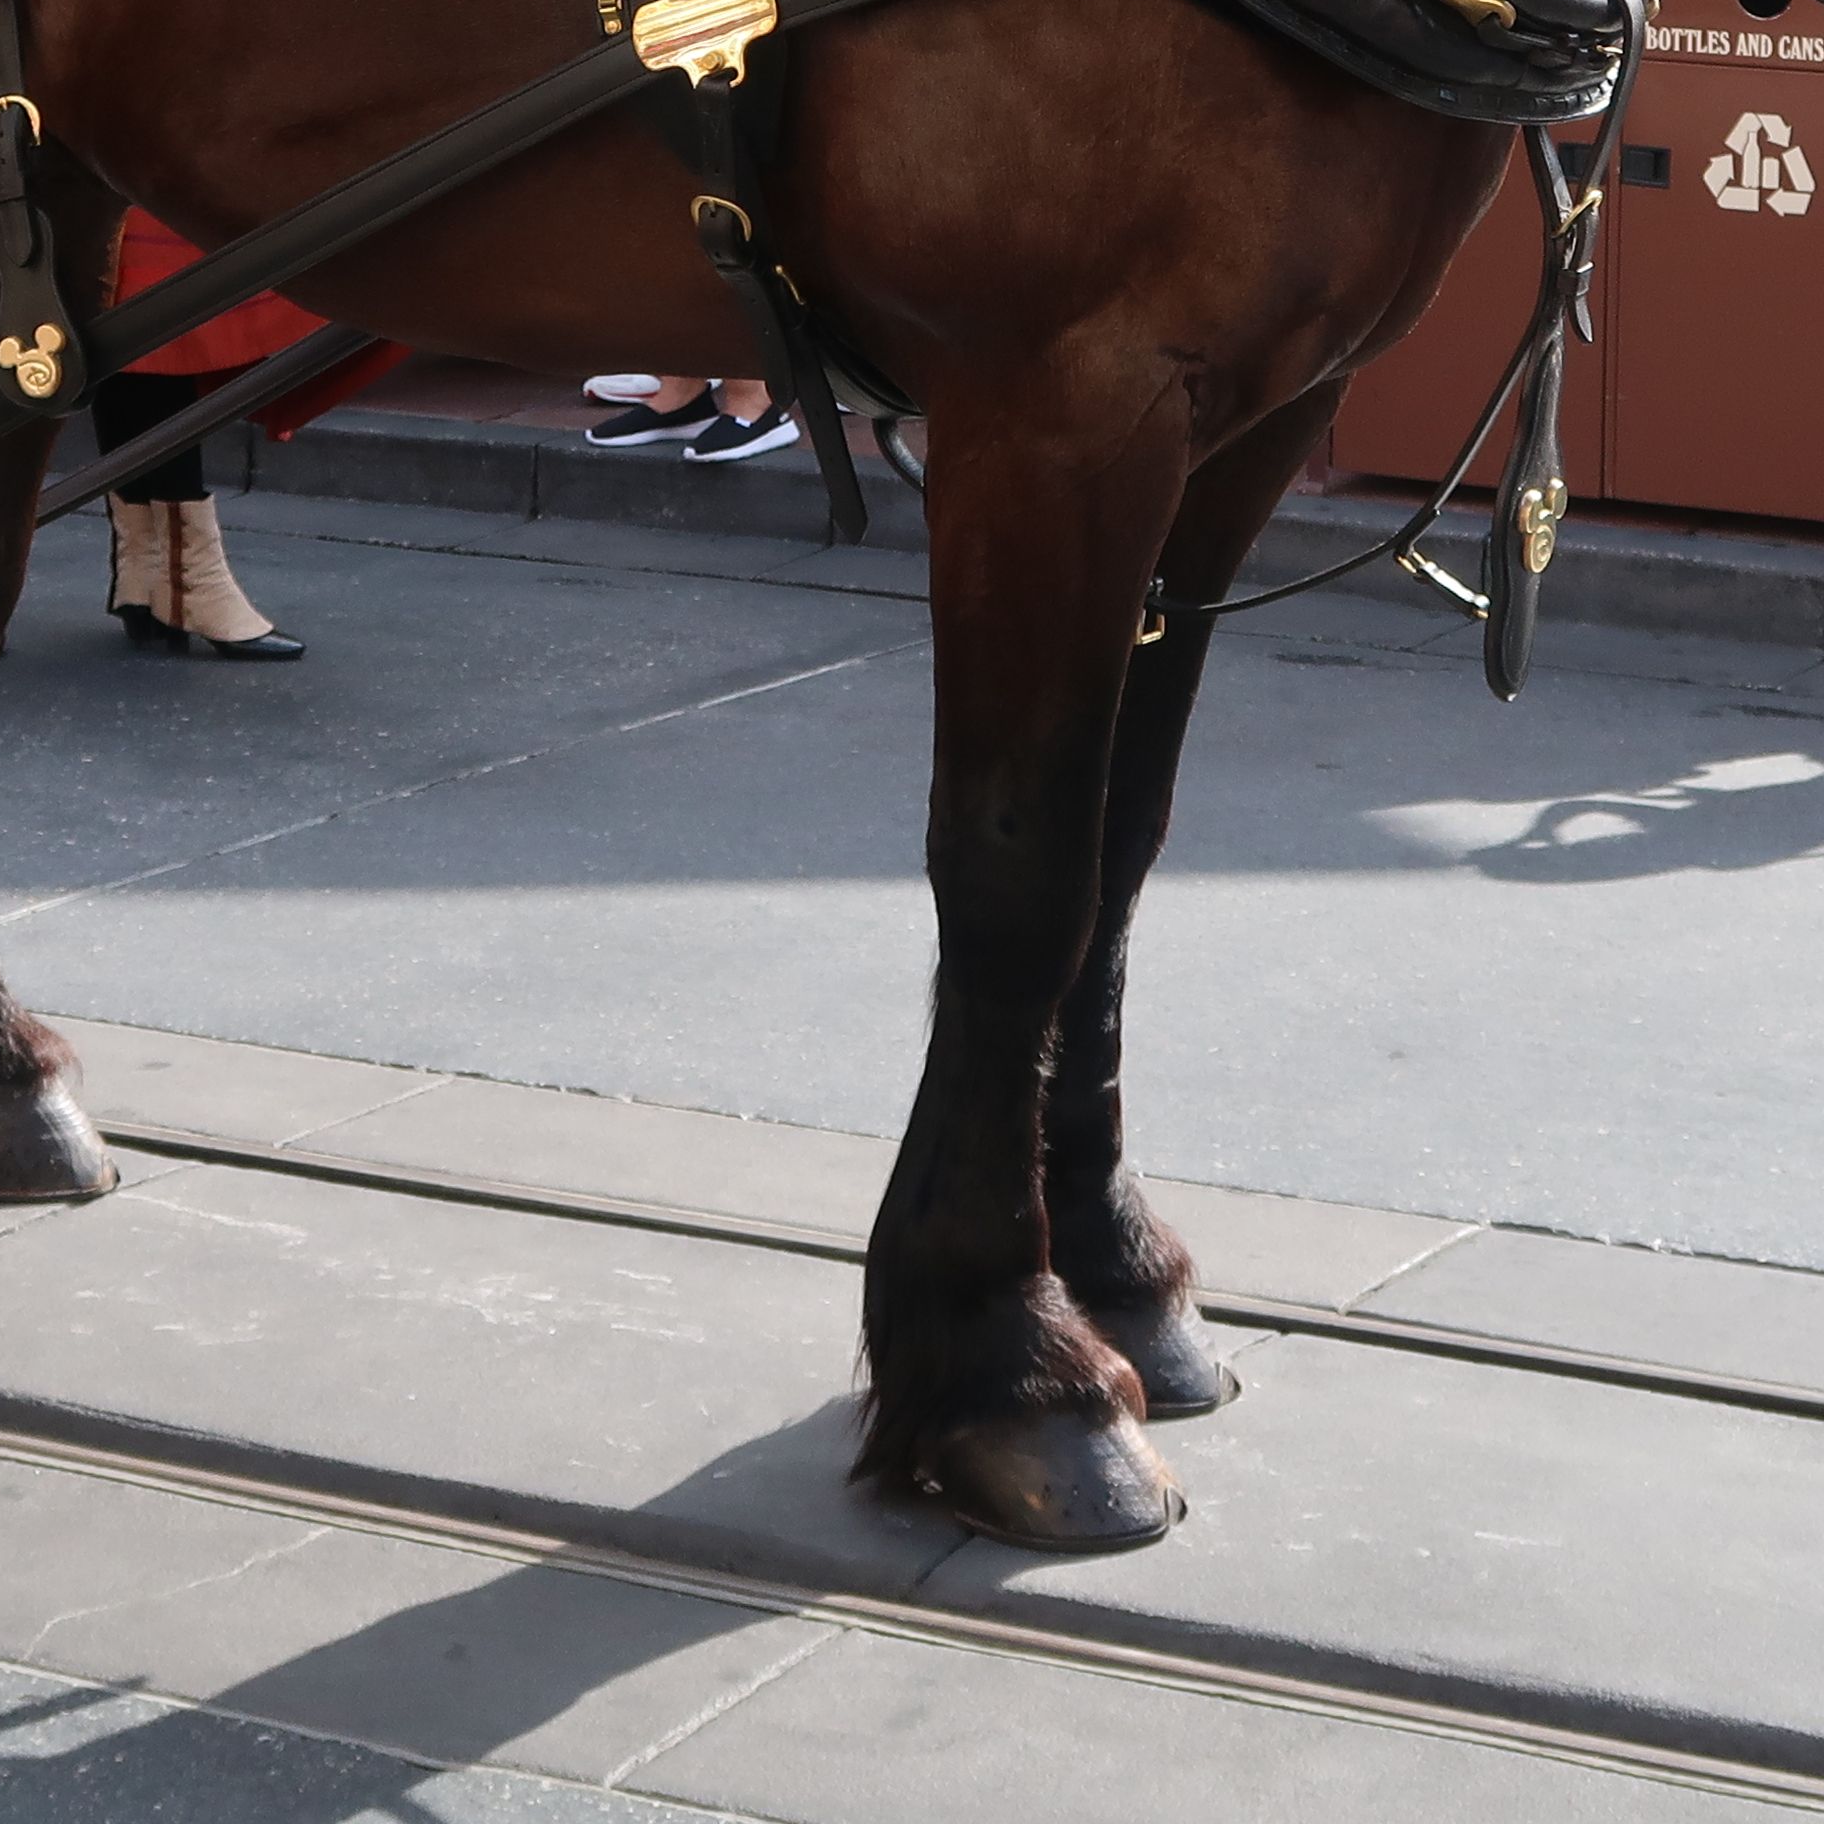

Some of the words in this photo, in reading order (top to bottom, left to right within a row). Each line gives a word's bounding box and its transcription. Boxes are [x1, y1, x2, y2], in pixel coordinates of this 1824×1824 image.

[1645, 25, 1730, 56] BOTTLES
[1735, 33, 1773, 59] AND
[1778, 34, 1824, 63] CANS
